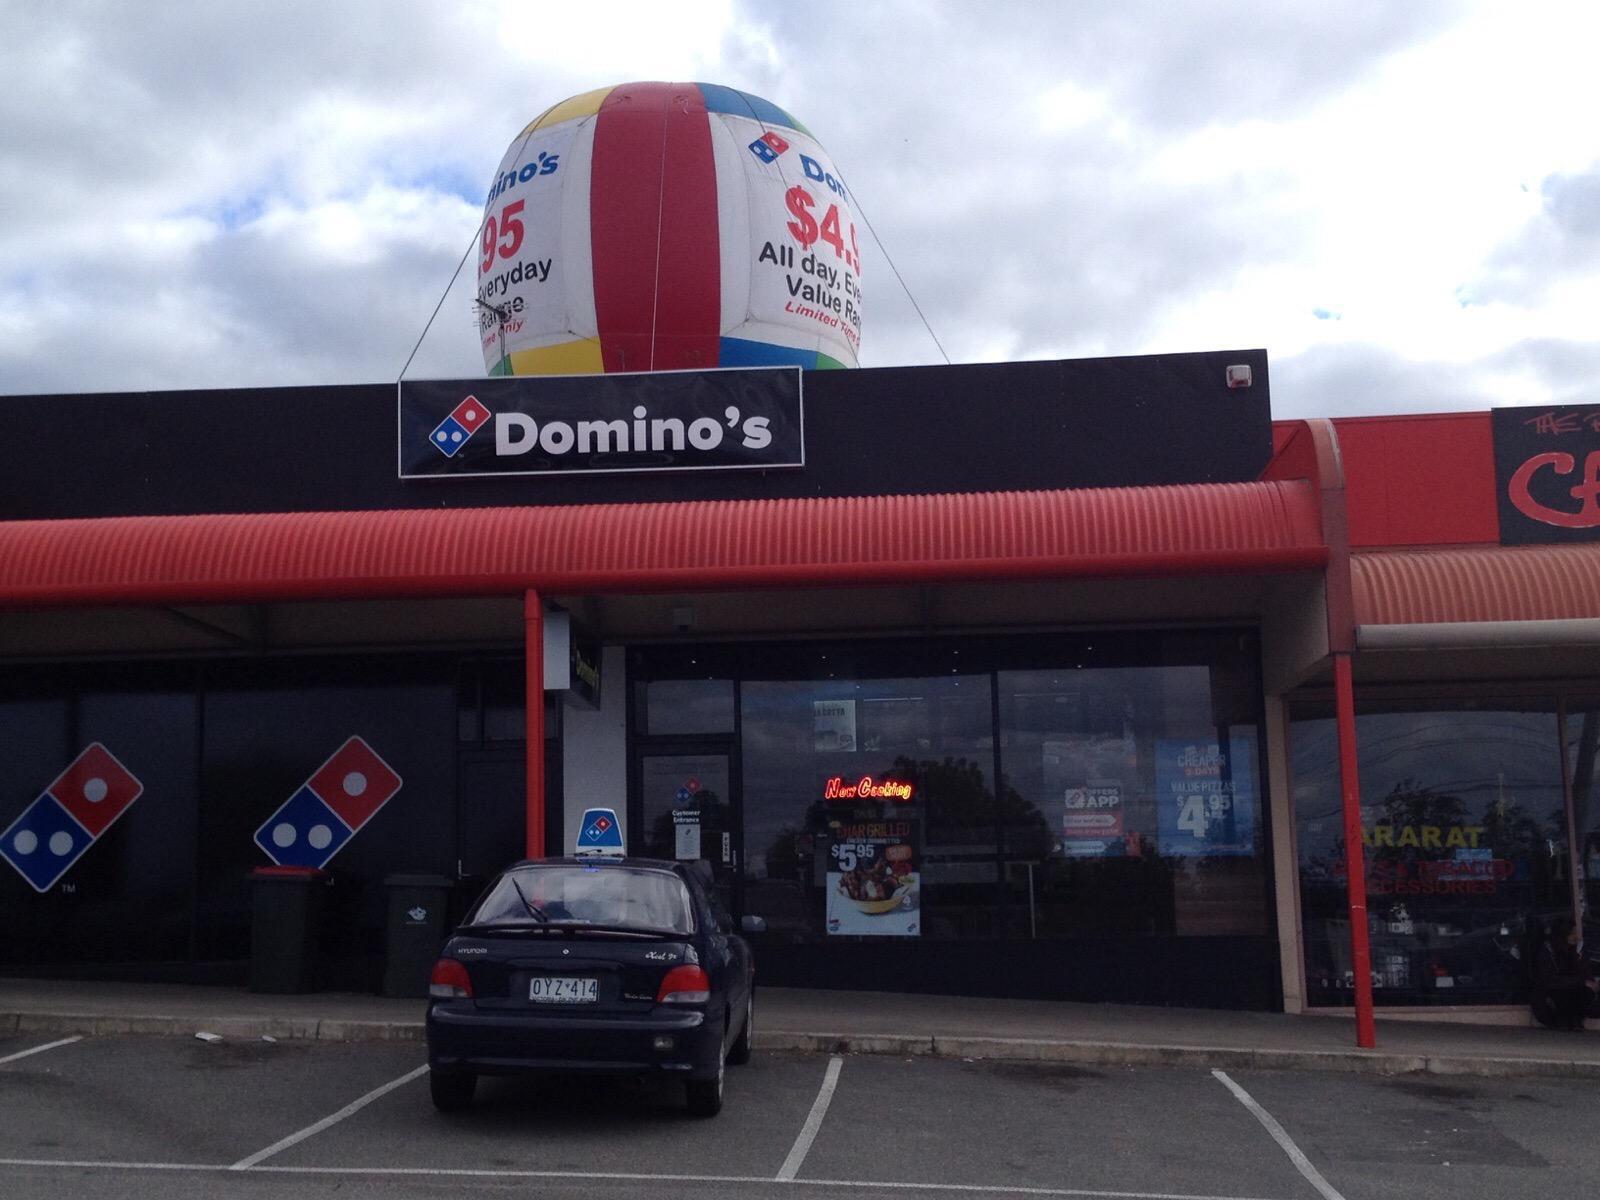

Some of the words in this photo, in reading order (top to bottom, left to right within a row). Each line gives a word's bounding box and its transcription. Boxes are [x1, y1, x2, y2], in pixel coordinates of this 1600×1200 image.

[759, 241, 794, 269] All
[802, 254, 841, 290] day,
[786, 275, 842, 313] Value
[785, 301, 838, 328] Limited
[496, 406, 772, 456] Domino's
[1524, 412, 1583, 435] THE
[825, 777, 857, 799] Now
[858, 776, 911, 799] Cooking
[1086, 796, 1119, 808] APP
